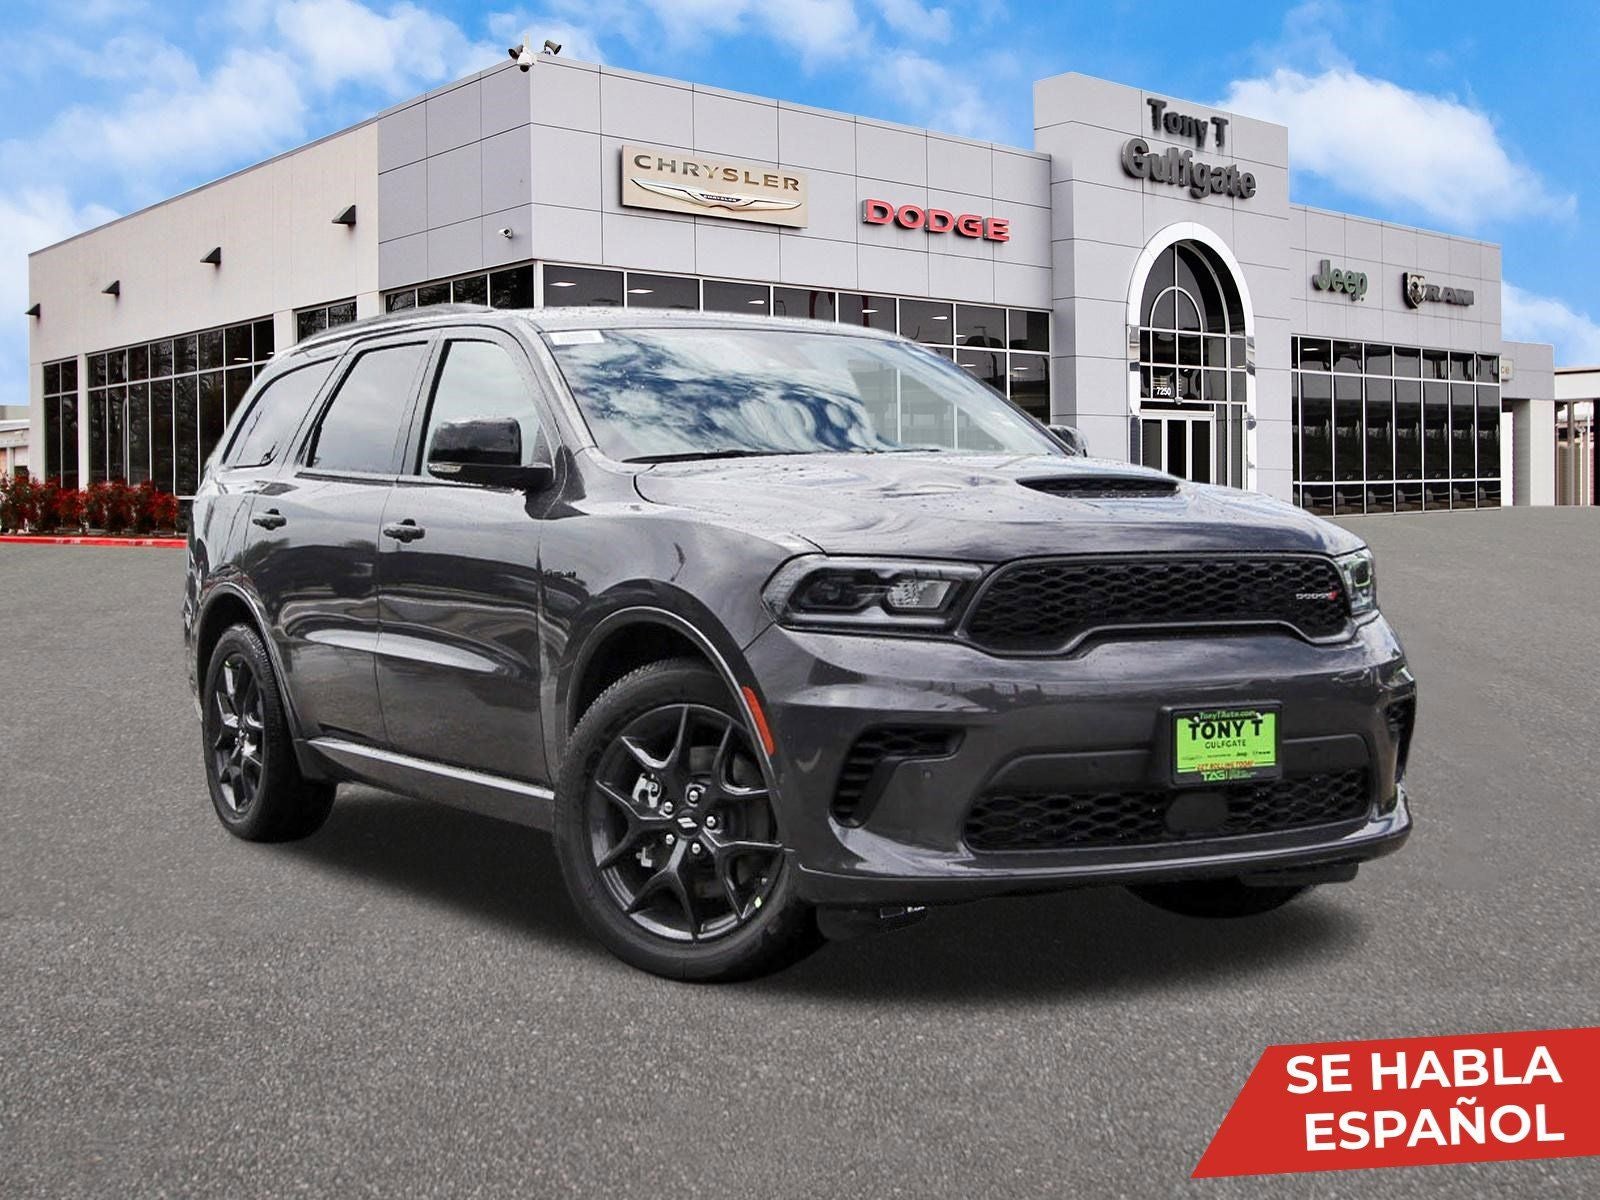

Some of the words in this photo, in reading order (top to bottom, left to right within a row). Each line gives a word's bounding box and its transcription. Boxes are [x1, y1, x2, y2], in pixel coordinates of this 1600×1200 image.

[1147, 98, 1208, 147] Tony
[1211, 117, 1229, 147] T
[634, 154, 800, 192] CHRYSLER
[1121, 138, 1256, 199] Gulfgate
[863, 198, 1010, 242] DODGE
[1313, 260, 1368, 301] Jeep
[1425, 284, 1475, 306] RAM
[1156, 386, 1172, 396] 7250
[1188, 720, 1245, 740] TONY
[1251, 719, 1263, 736] T
[1205, 739, 1246, 749] GULFGATE
